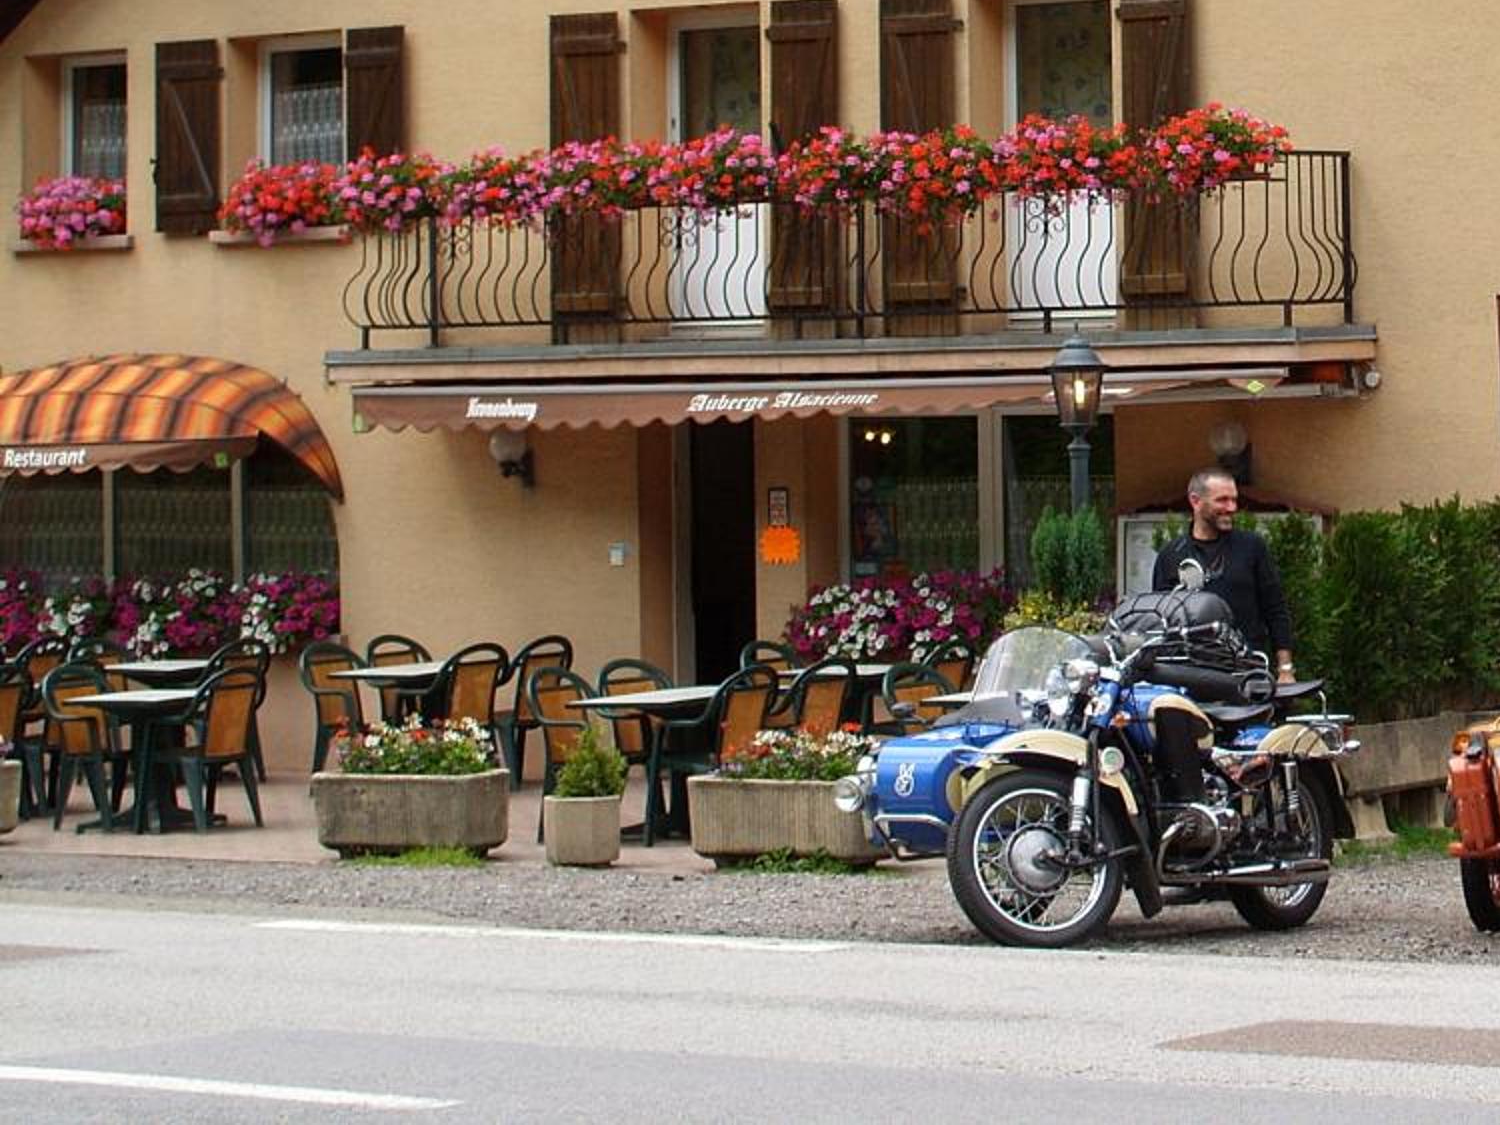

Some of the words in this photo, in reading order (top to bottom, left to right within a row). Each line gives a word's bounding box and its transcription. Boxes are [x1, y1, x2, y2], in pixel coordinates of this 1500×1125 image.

[687, 393, 769, 412] Auberge
[773, 391, 879, 409] Alsacienne
[4, 448, 87, 469] Restaurant
